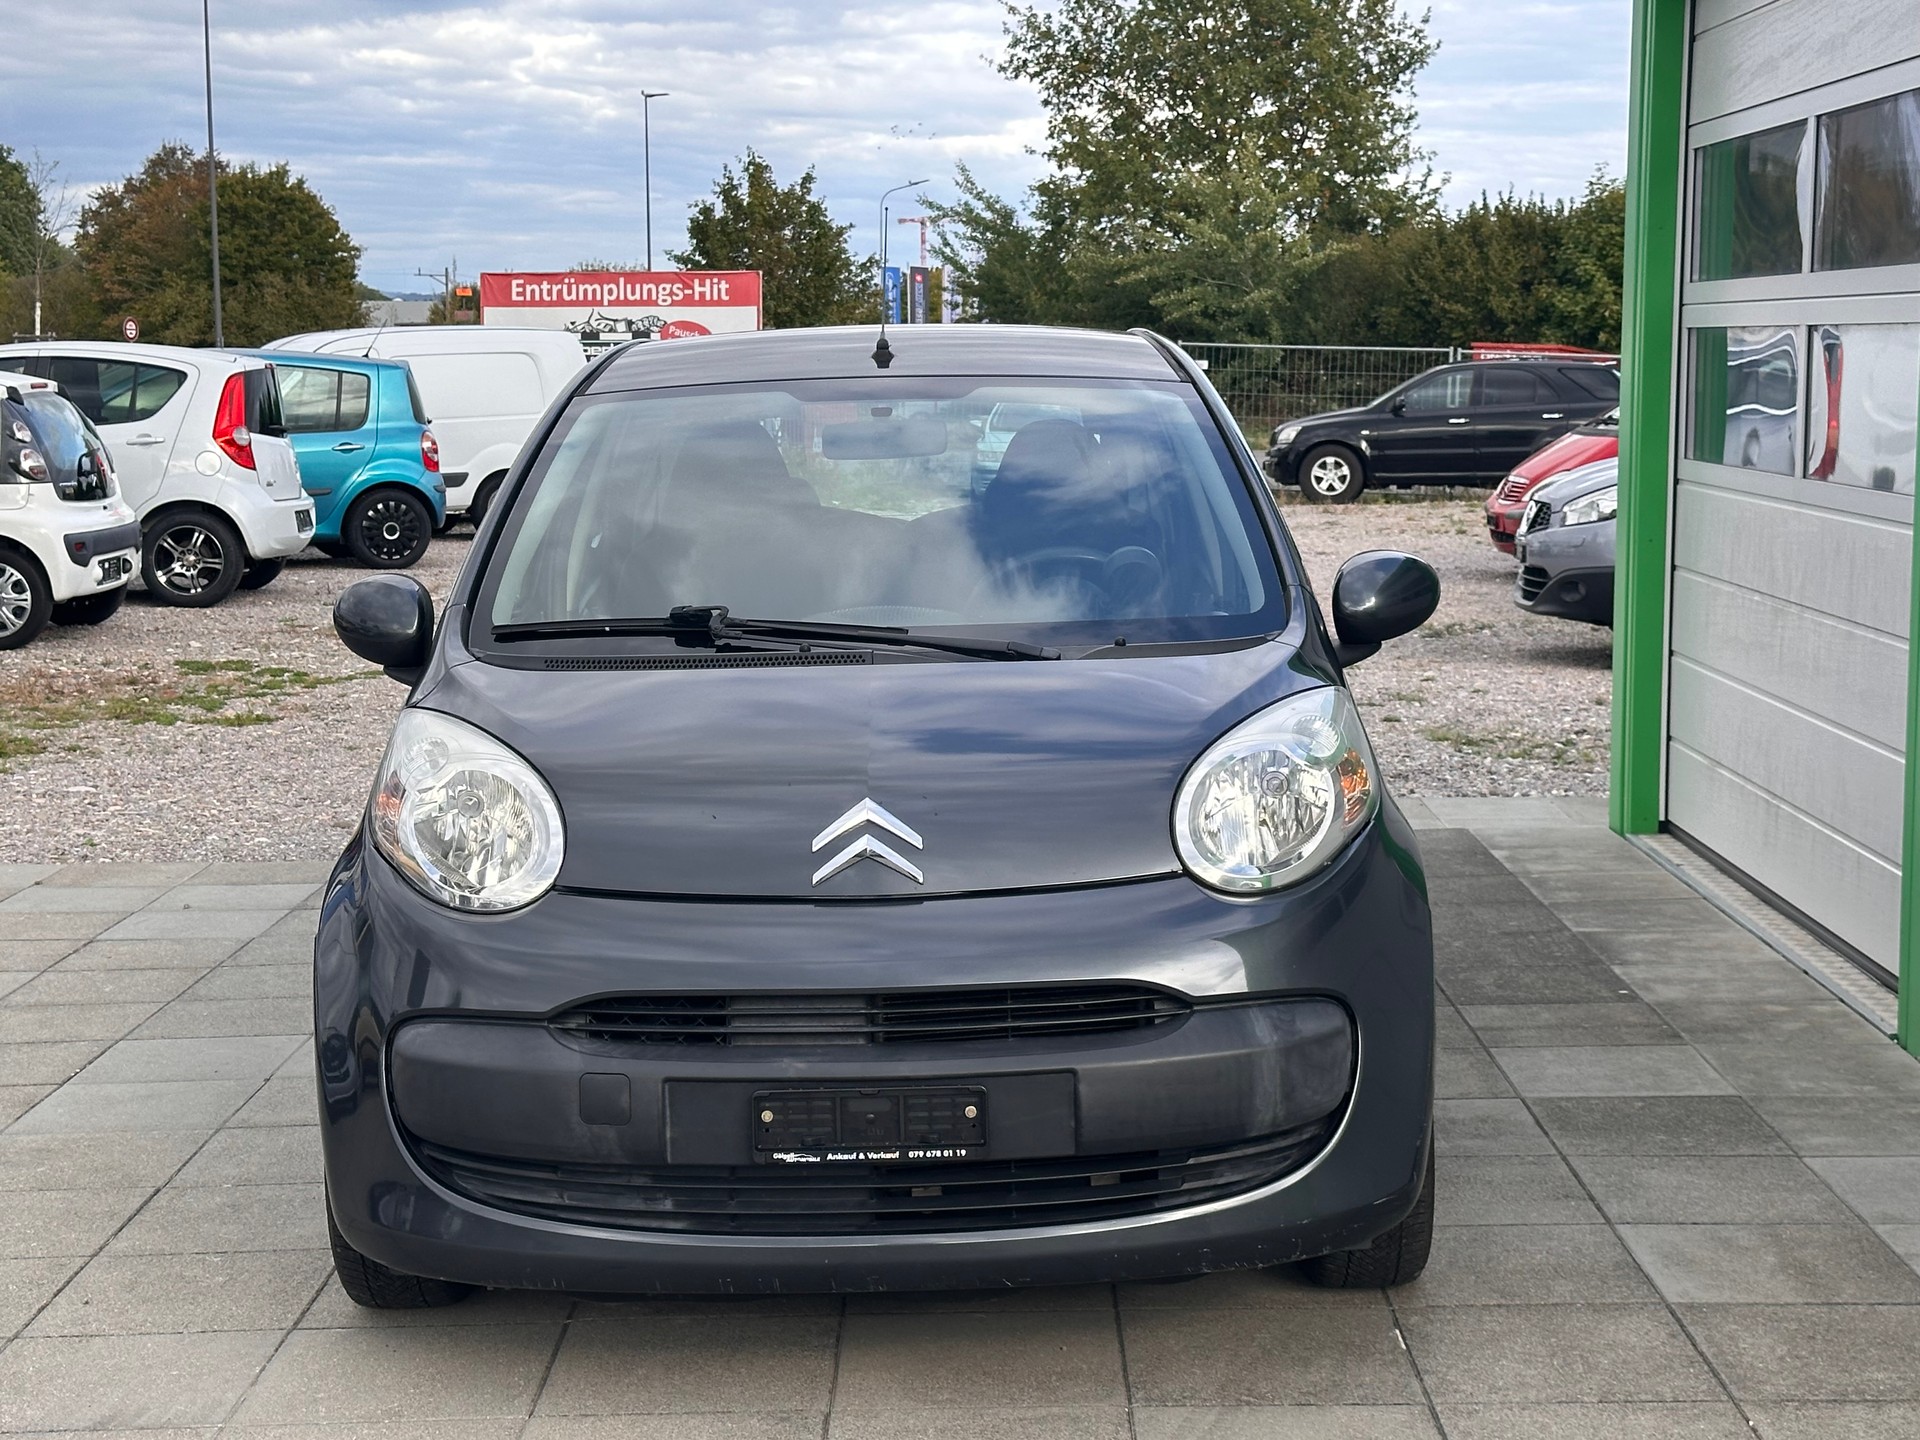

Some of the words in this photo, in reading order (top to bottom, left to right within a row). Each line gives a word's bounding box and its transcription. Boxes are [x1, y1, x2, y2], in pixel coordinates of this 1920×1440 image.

[511, 277, 730, 306] Entrümplungs-Hit
[826, 1152, 857, 1160] Ankauf
[858, 1152, 865, 1160] &
[866, 1151, 900, 1160] Verkauf
[908, 1150, 925, 1159] 079
[925, 1150, 942, 1158] 678
[943, 1149, 953, 1157] 01
[955, 1149, 967, 1157] 19
